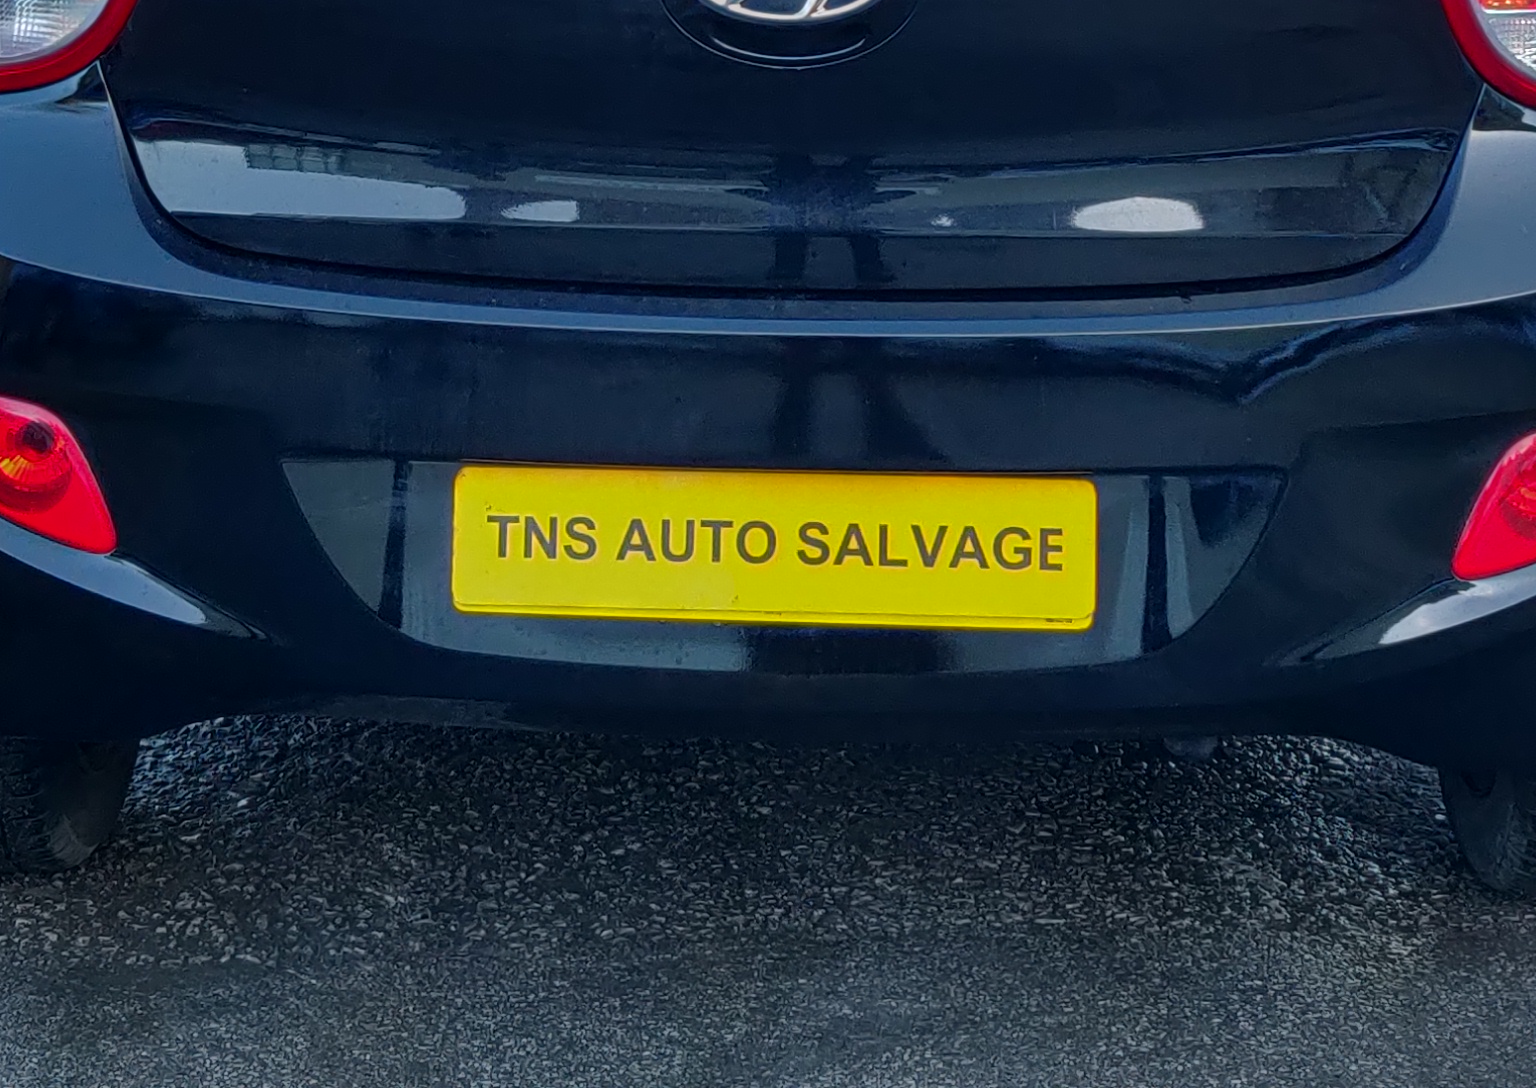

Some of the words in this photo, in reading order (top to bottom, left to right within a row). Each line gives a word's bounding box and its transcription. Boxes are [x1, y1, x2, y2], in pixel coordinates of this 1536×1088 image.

[486, 514, 598, 560] TNS
[616, 519, 777, 565] AUTO
[796, 521, 1064, 572] SALVAGE
